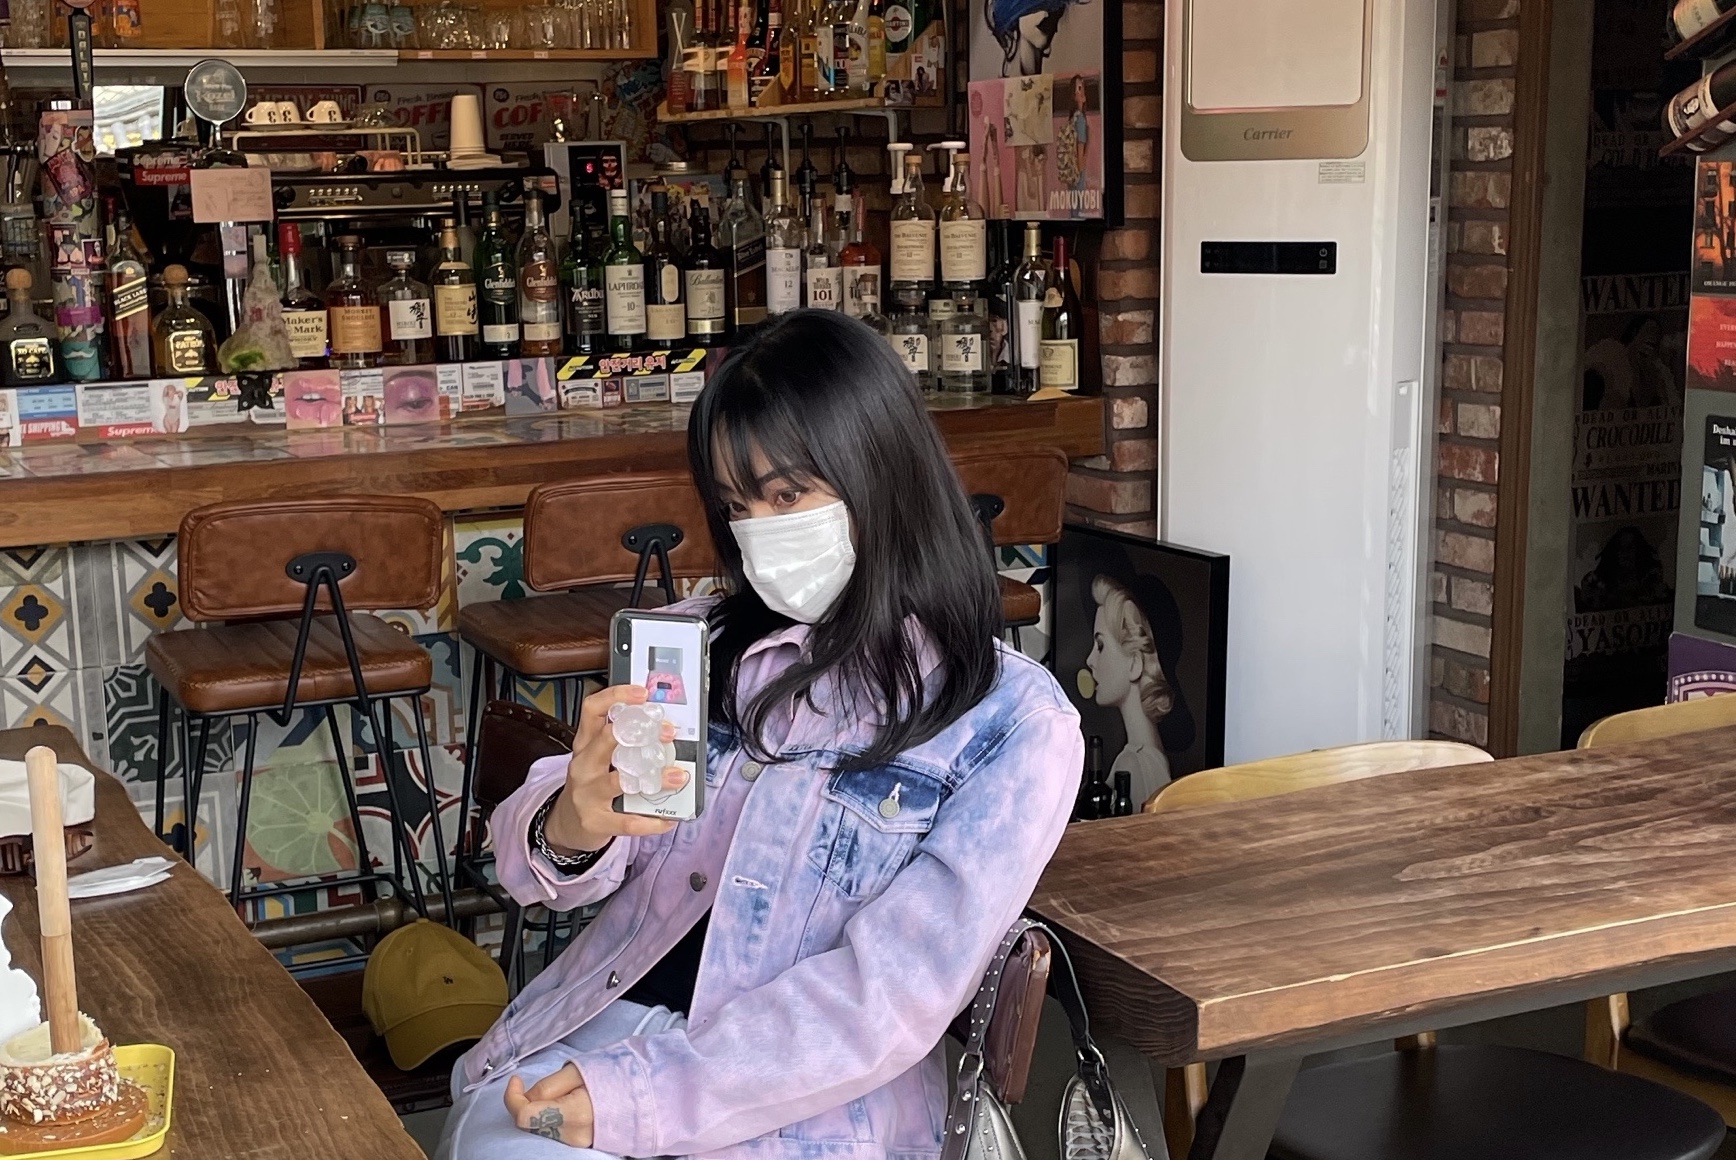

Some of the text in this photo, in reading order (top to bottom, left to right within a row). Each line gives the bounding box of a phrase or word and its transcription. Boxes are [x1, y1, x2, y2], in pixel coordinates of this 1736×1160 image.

[1243, 127, 1293, 141] Carrier
[142, 170, 187, 184] Supreme
[1049, 189, 1100, 210] MOKUYOBI
[784, 279, 793, 288] 12
[813, 289, 833, 301] 101
[627, 302, 636, 311] 10
[293, 325, 323, 333] Mark
[1582, 411, 1615, 425] DEAD
[1623, 409, 1638, 421] OR
[27, 421, 63, 434] SHIPPING
[1586, 420, 1676, 450] CROCODILE
[1575, 612, 1606, 628] DEAD
[1614, 610, 1629, 624] OR
